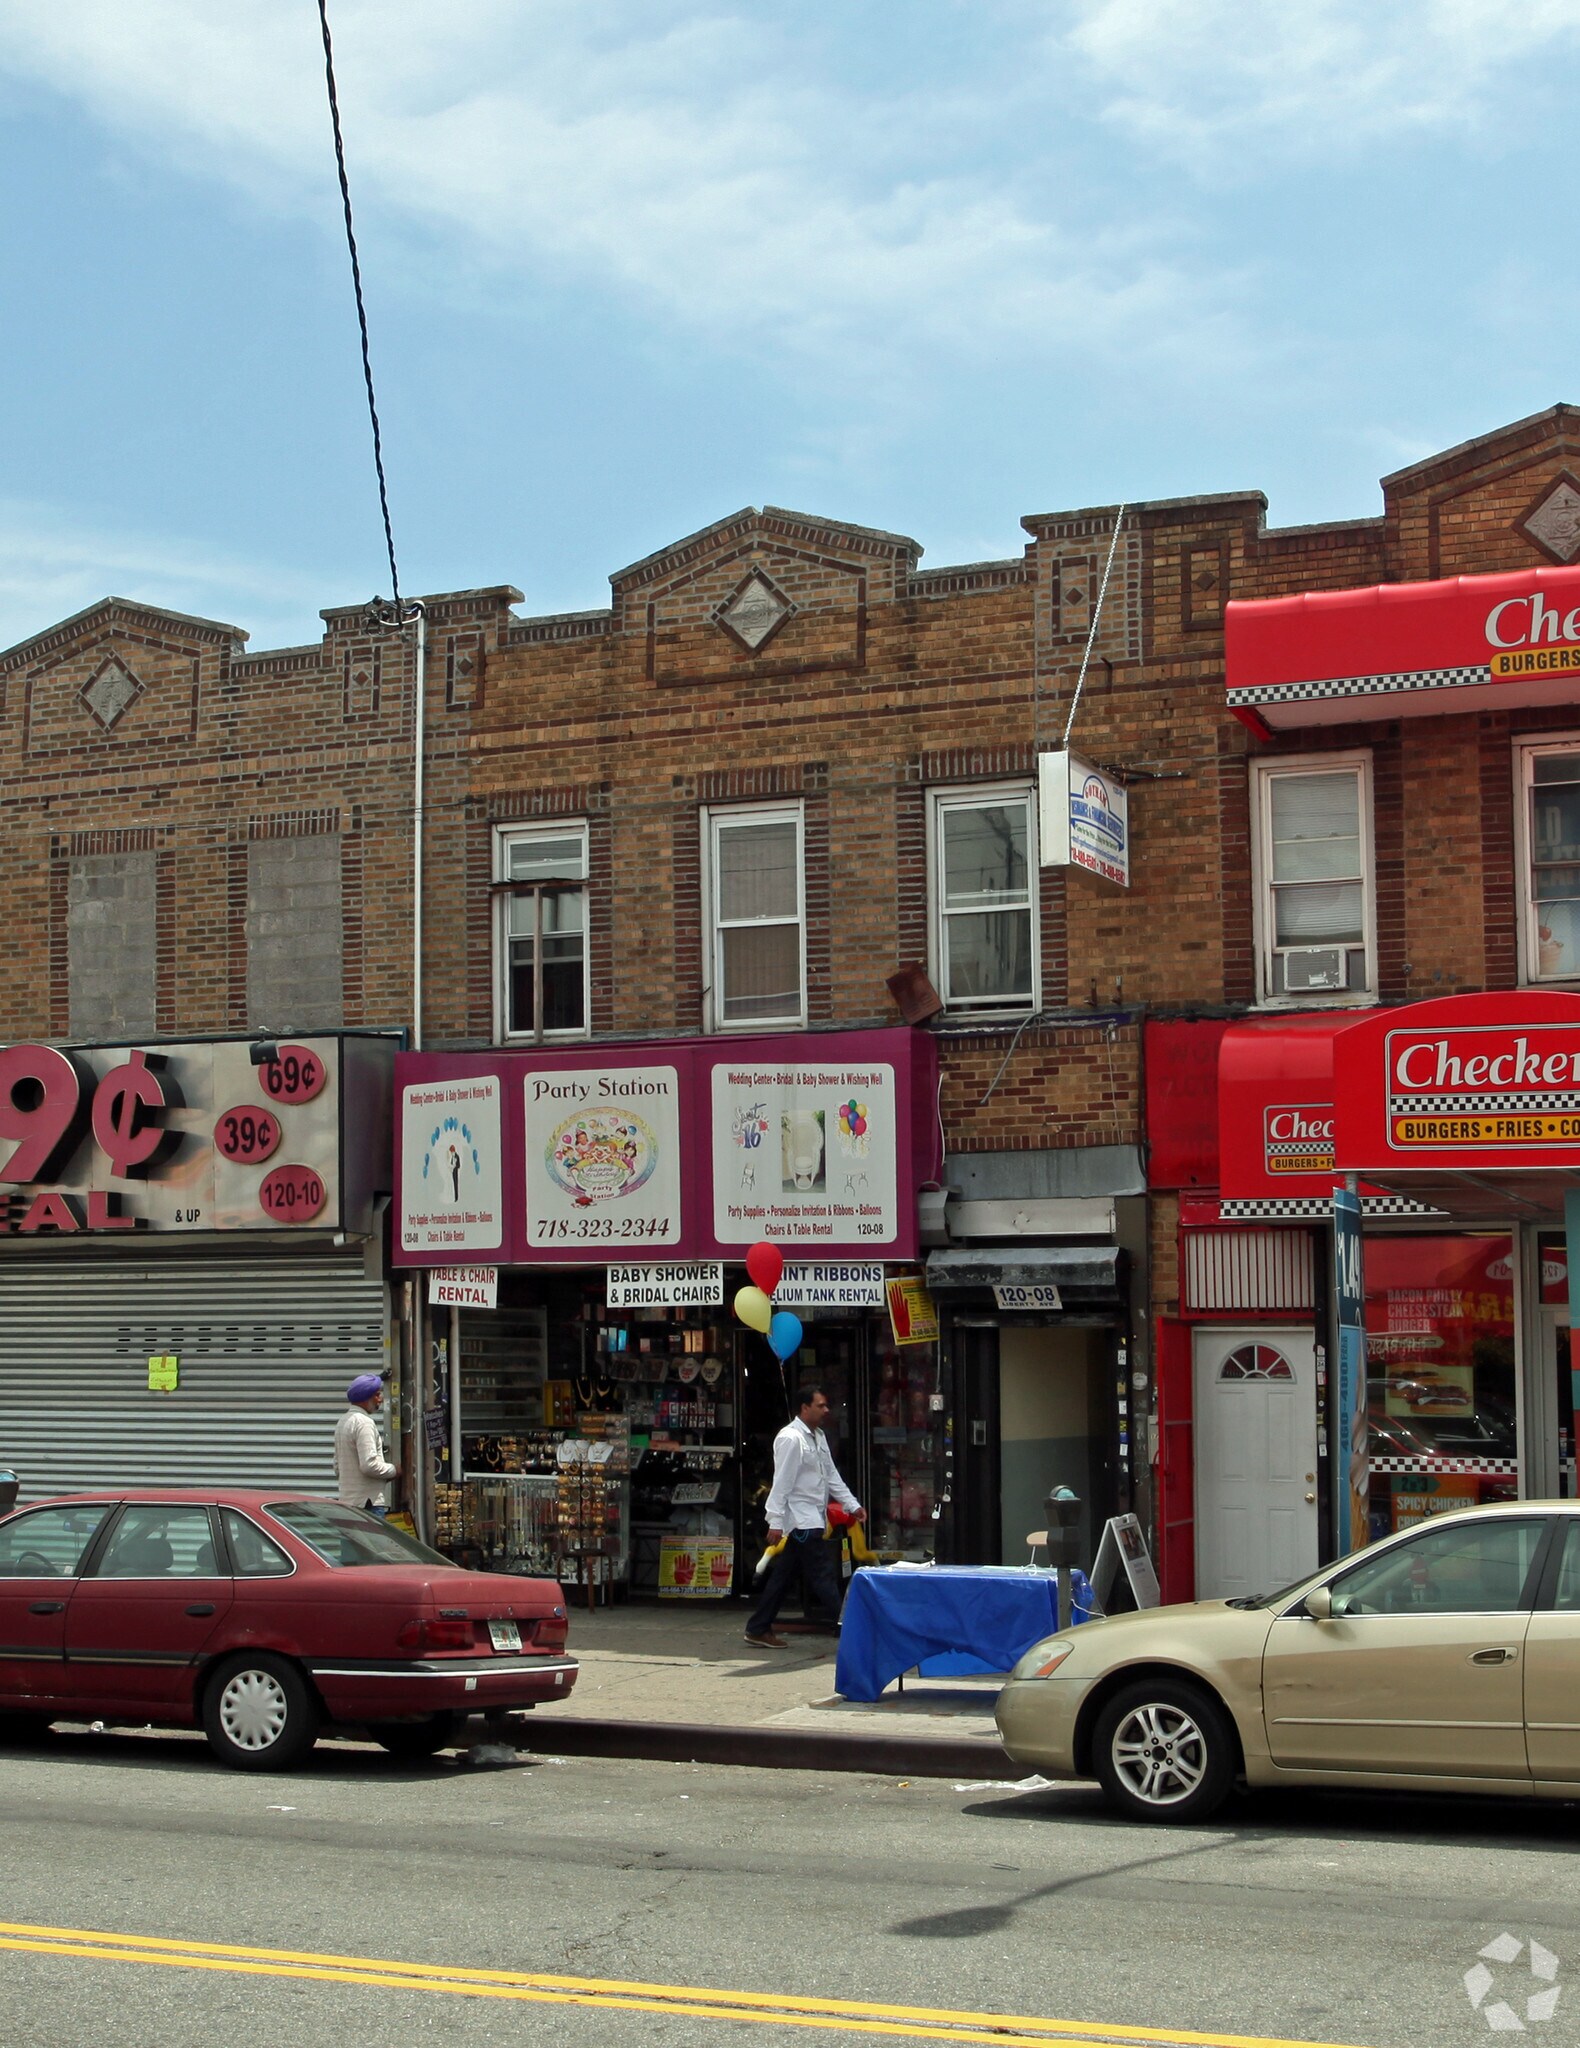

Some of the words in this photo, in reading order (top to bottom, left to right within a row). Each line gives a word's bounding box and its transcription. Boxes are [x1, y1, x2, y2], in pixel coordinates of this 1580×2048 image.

[1485, 592, 1580, 648] Che
[1500, 649, 1580, 673] BURGERS
[1396, 1037, 1580, 1088] Checker
[267, 1055, 316, 1094] 69¢
[727, 1072, 752, 1088] Wedding
[753, 1072, 772, 1085] Center
[777, 1072, 793, 1085] Bridal
[796, 1072, 801, 1085] &
[802, 1072, 817, 1088] Baby
[818, 1072, 839, 1085] Shower
[841, 1072, 845, 1085] &
[846, 1072, 869, 1088] Wishing
[870, 1072, 882, 1085] Well
[532, 1079, 591, 1102] Party
[598, 1075, 669, 1097] Station
[1270, 1111, 1334, 1140] Chec
[1405, 1121, 1480, 1139] BURGERS
[1497, 1120, 1543, 1137] FRIES
[223, 1116, 270, 1154] 39¢
[743, 1121, 762, 1149] 16
[1275, 1157, 1318, 1169] BURGERS
[264, 1181, 320, 1208] 120-10
[0, 1191, 135, 1230] AL
[175, 1210, 183, 1223] &
[186, 1208, 201, 1222] UP
[728, 1204, 743, 1220] Party
[743, 1204, 766, 1220] Supplies
[771, 1204, 801, 1216] Personalize
[802, 1203, 826, 1216] Invitation
[828, 1203, 832, 1216] &
[833, 1203, 855, 1216] Ribbons
[859, 1203, 882, 1216] Balloons
[537, 1218, 670, 1238] 718-323-2344
[764, 1223, 785, 1236] Chairs
[787, 1223, 792, 1235] &
[793, 1223, 811, 1235] Table
[812, 1222, 833, 1235] Rental
[857, 1223, 884, 1235] 120-08
[431, 1267, 457, 1282] TABLE
[460, 1268, 466, 1282] &
[469, 1268, 495, 1284] CHAIR
[611, 1267, 652, 1283] BABY
[655, 1265, 719, 1281] SHOWER
[814, 1266, 882, 1281] RIBBONS
[438, 1286, 489, 1304] RENTAL
[610, 1288, 619, 1304] &
[624, 1287, 668, 1304] BRIDAL
[673, 1285, 720, 1302] CHAIRS
[806, 1288, 835, 1302] TANK
[839, 1287, 881, 1302] RENTAL
[999, 1287, 1055, 1302] 120-08
[1387, 1289, 1423, 1303] BACON
[1426, 1289, 1463, 1303] PHILLY
[1387, 1303, 1464, 1318] CHEESESTEAK
[1387, 1318, 1431, 1332] BURGER
[1397, 1496, 1427, 1511] SPICY
[1429, 1497, 1475, 1511] CHICKEN
